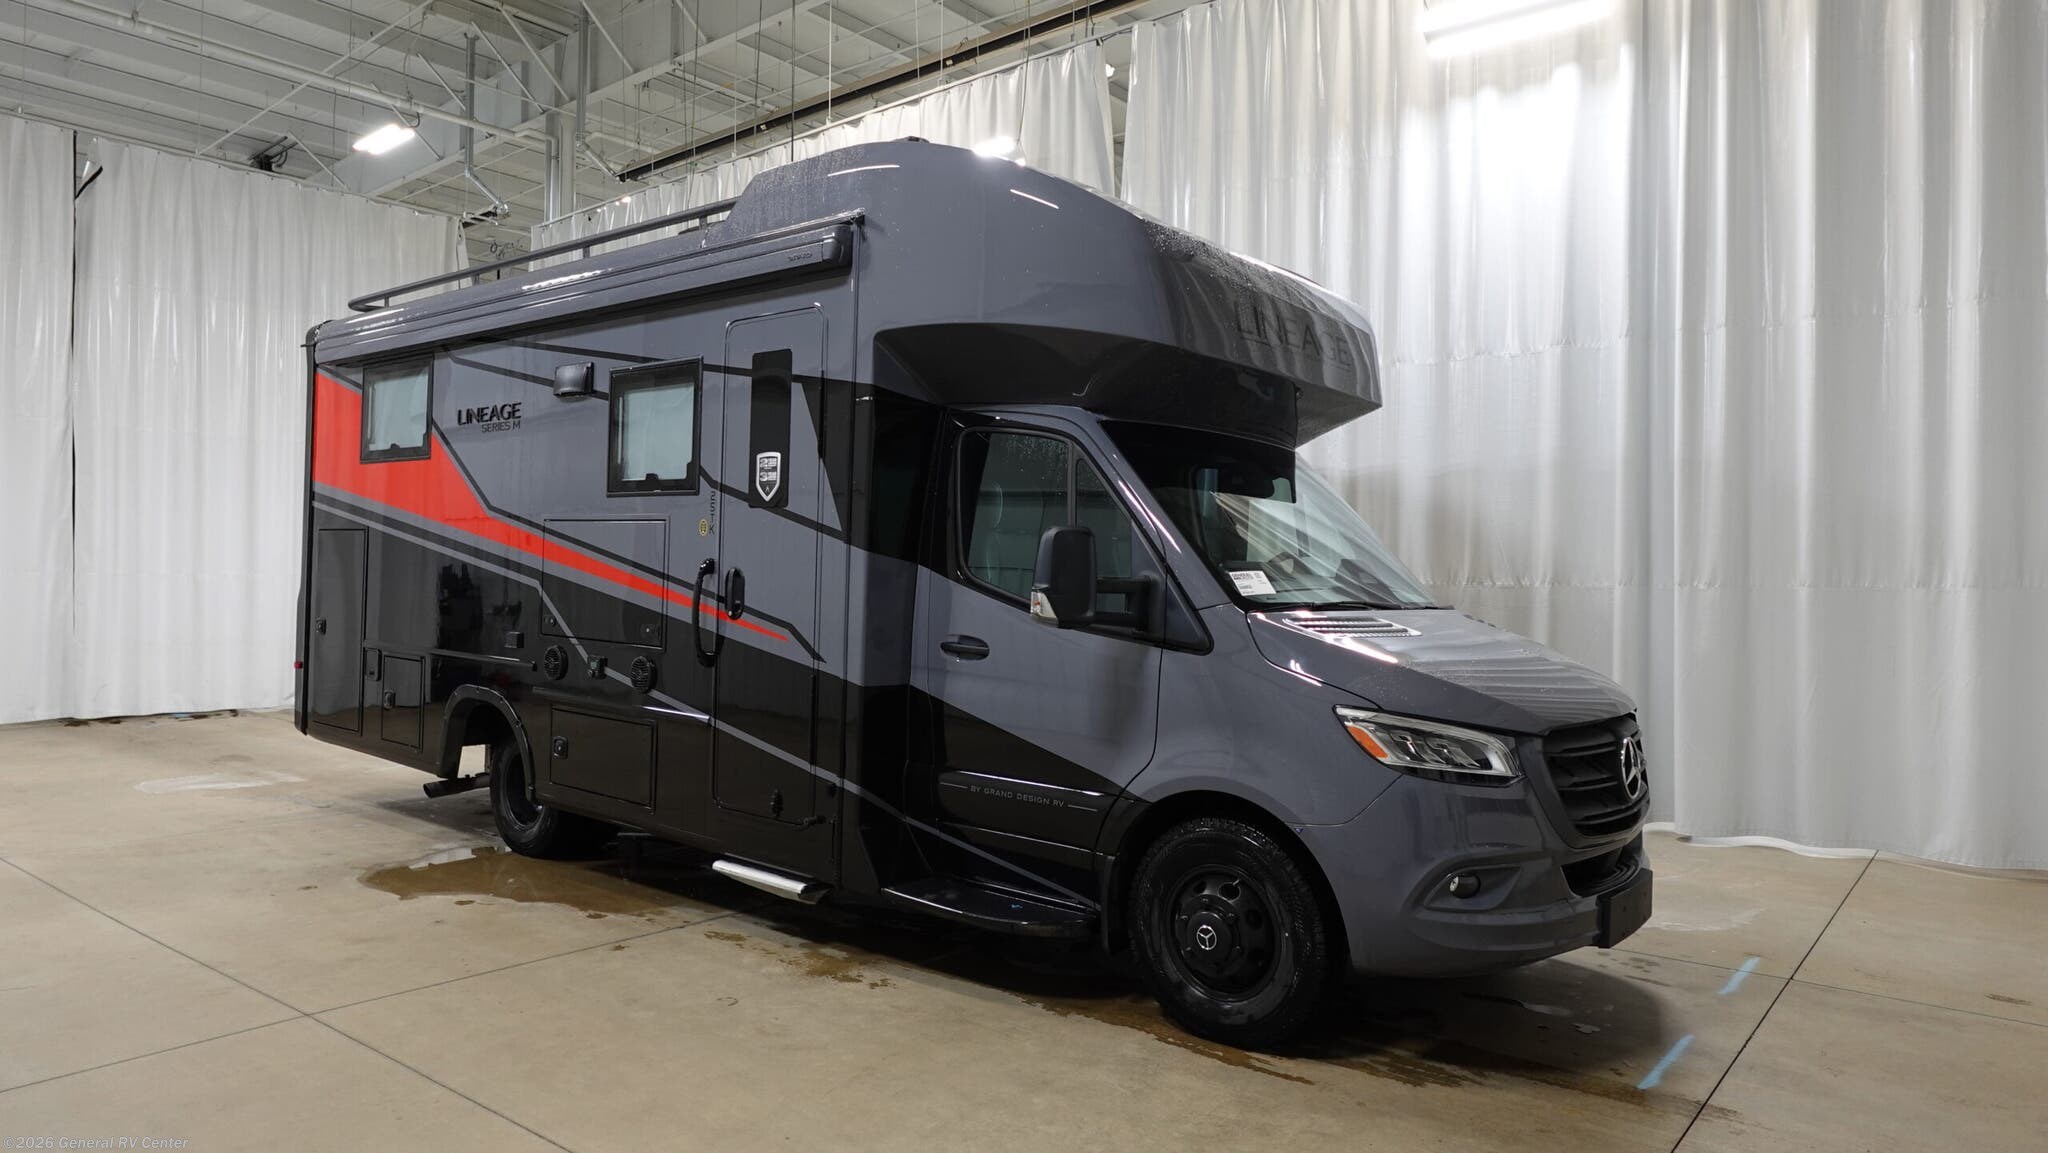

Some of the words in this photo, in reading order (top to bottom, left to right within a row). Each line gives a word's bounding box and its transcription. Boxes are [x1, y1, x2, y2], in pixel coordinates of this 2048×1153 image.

[1233, 301, 1351, 367] LINEAGE
[457, 402, 522, 426] LINEAGE
[481, 421, 511, 433] SERIES
[512, 420, 521, 430] M
[970, 785, 981, 793] BY
[984, 788, 1013, 799] GRAND
[1016, 793, 1050, 805] DESIGN
[1053, 799, 1064, 808] RV
